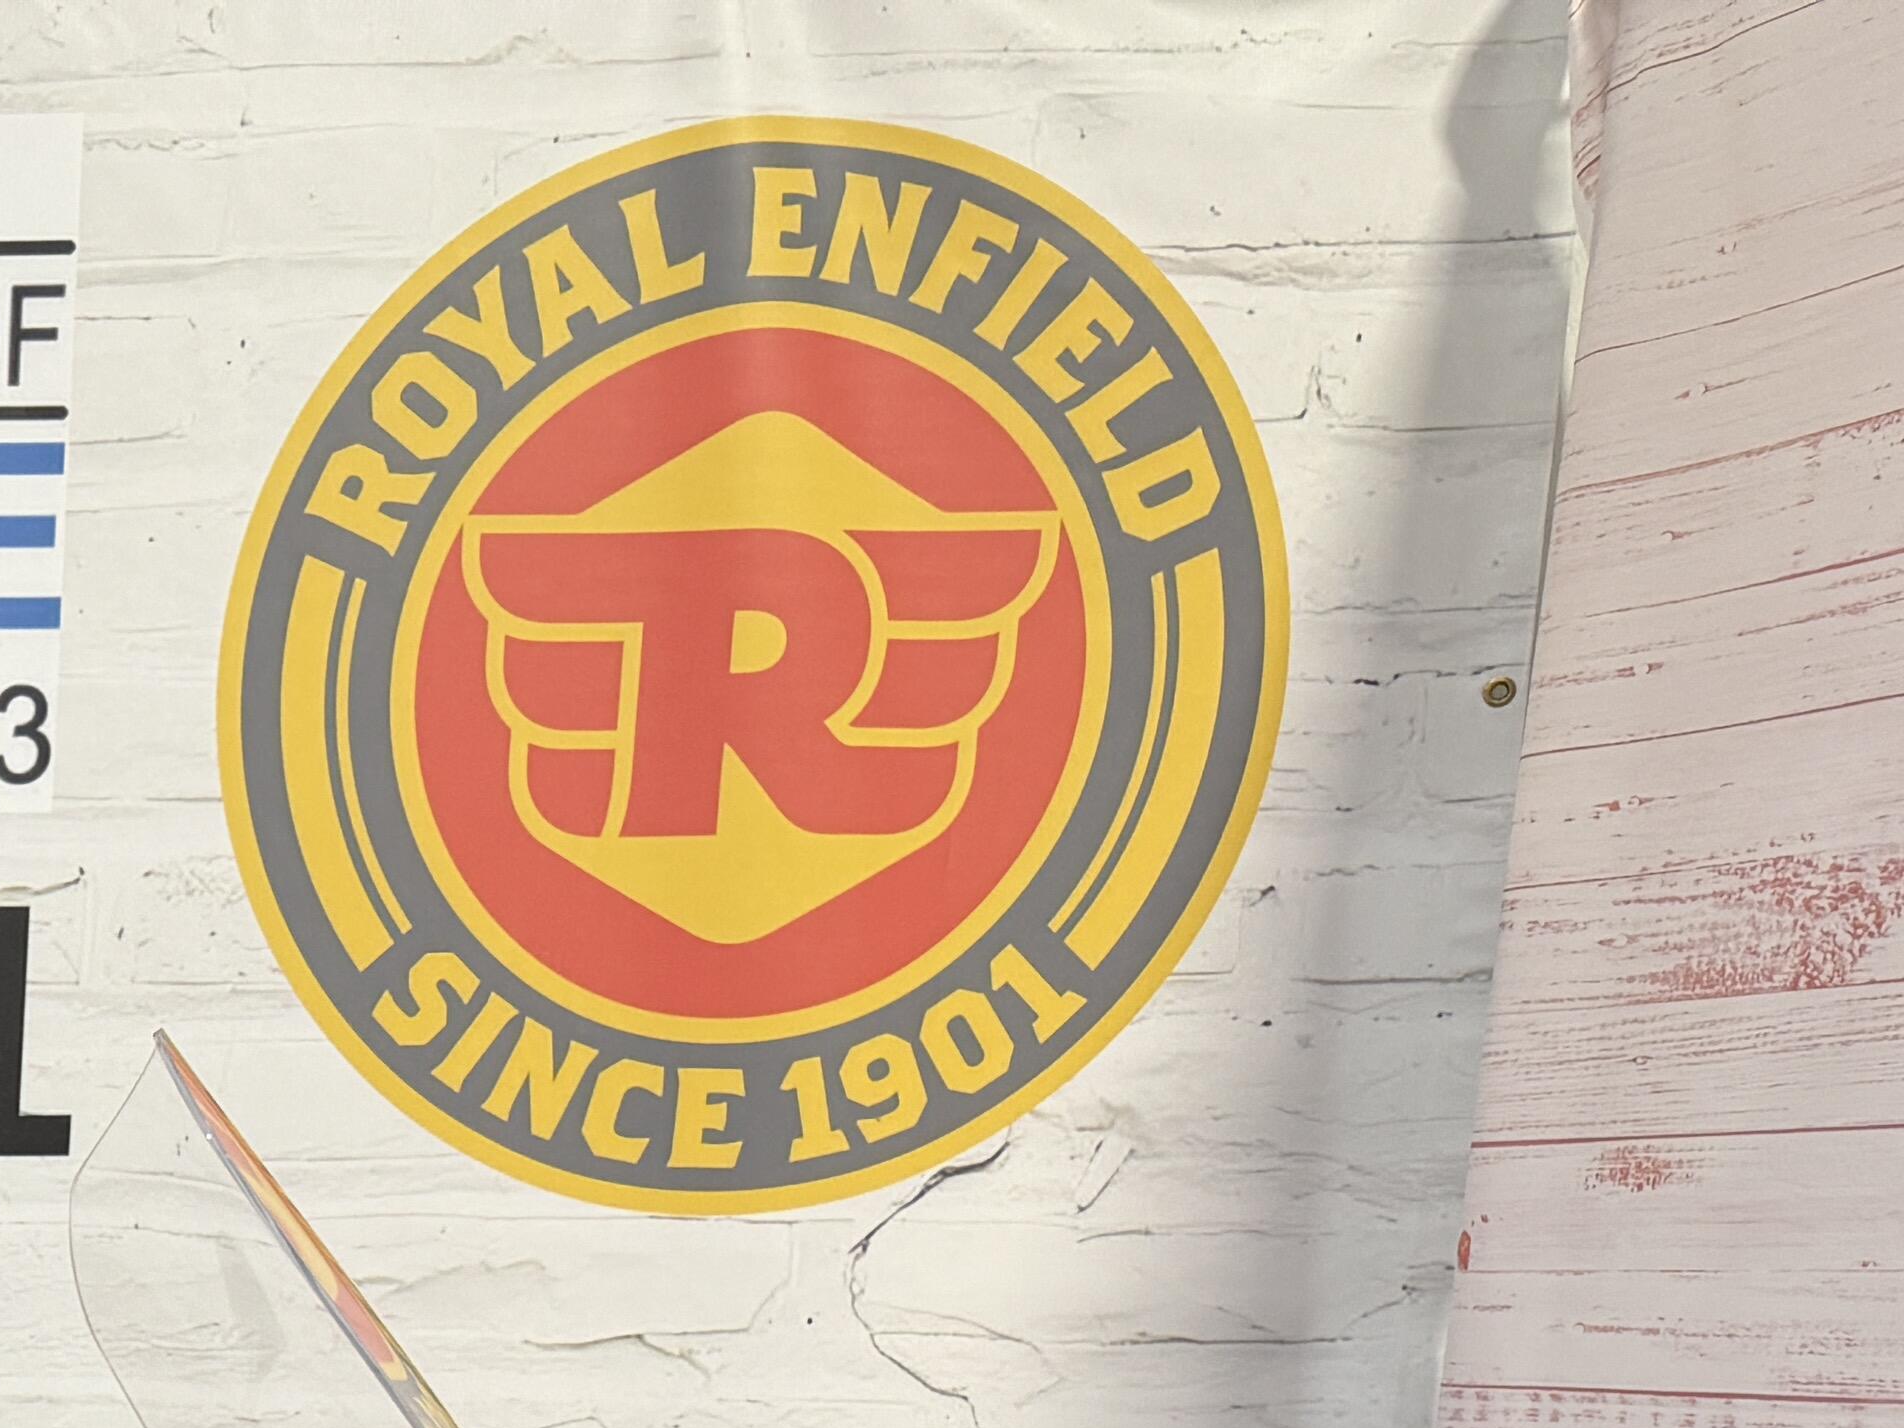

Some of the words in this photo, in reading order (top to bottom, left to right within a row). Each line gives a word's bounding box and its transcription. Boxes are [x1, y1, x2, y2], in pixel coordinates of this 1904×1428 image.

[307, 192, 708, 554] ROYAL
[747, 167, 1223, 543] ENFIELD
[373, 952, 748, 1170] SINCE
[782, 944, 1088, 1164] 1901
